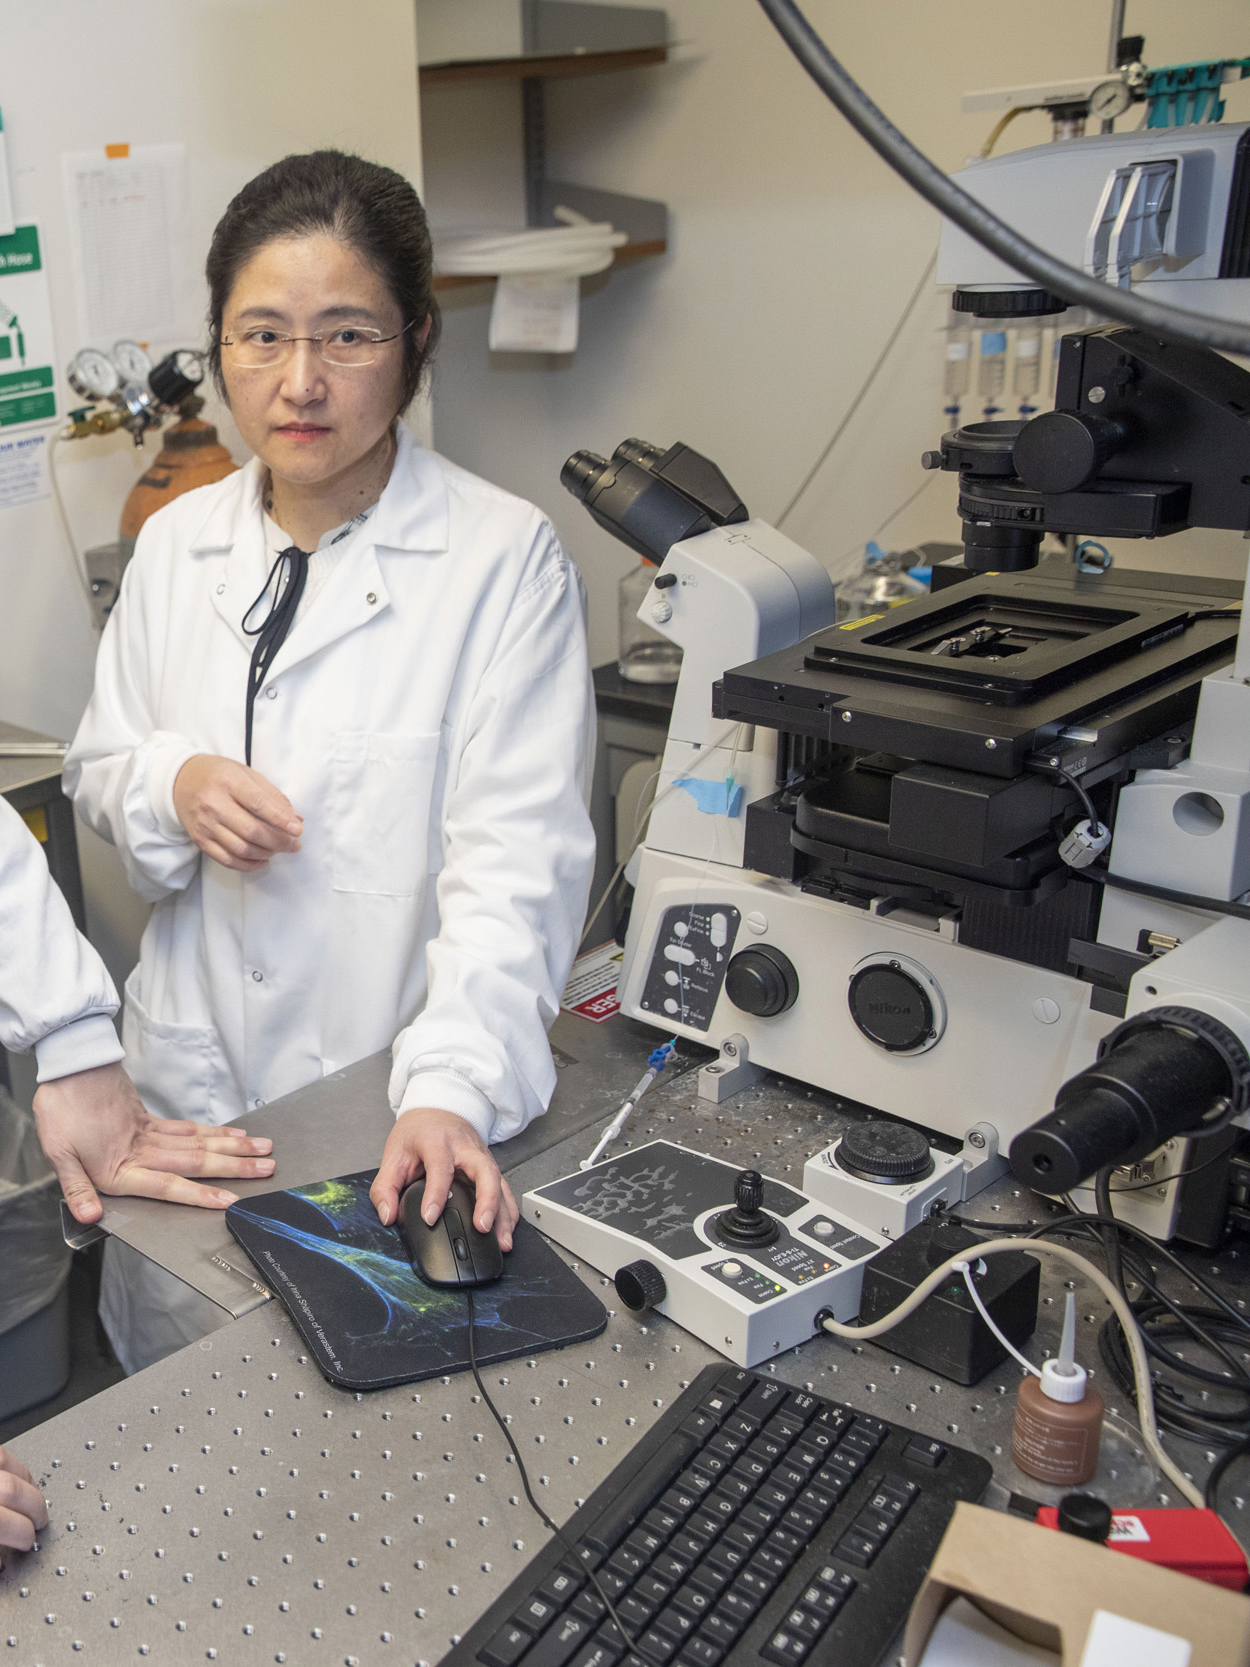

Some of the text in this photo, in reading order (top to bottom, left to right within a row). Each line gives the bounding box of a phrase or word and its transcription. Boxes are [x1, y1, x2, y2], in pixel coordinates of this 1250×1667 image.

[7, 253, 33, 267] Hose
[17, 436, 46, 449] WATER
[691, 982, 709, 993] Refocus
[690, 1011, 706, 1021] Escape
[775, 1250, 808, 1267] Nikon
[791, 1262, 807, 1271] Speed
[262, 1250, 274, 1263] Photo
[272, 1262, 289, 1282] Courtesy
[290, 1287, 302, 1299] Inna
[298, 1299, 315, 1322] Shapiro
[311, 1321, 321, 1329] of
[333, 1360, 344, 1374] Inc.
